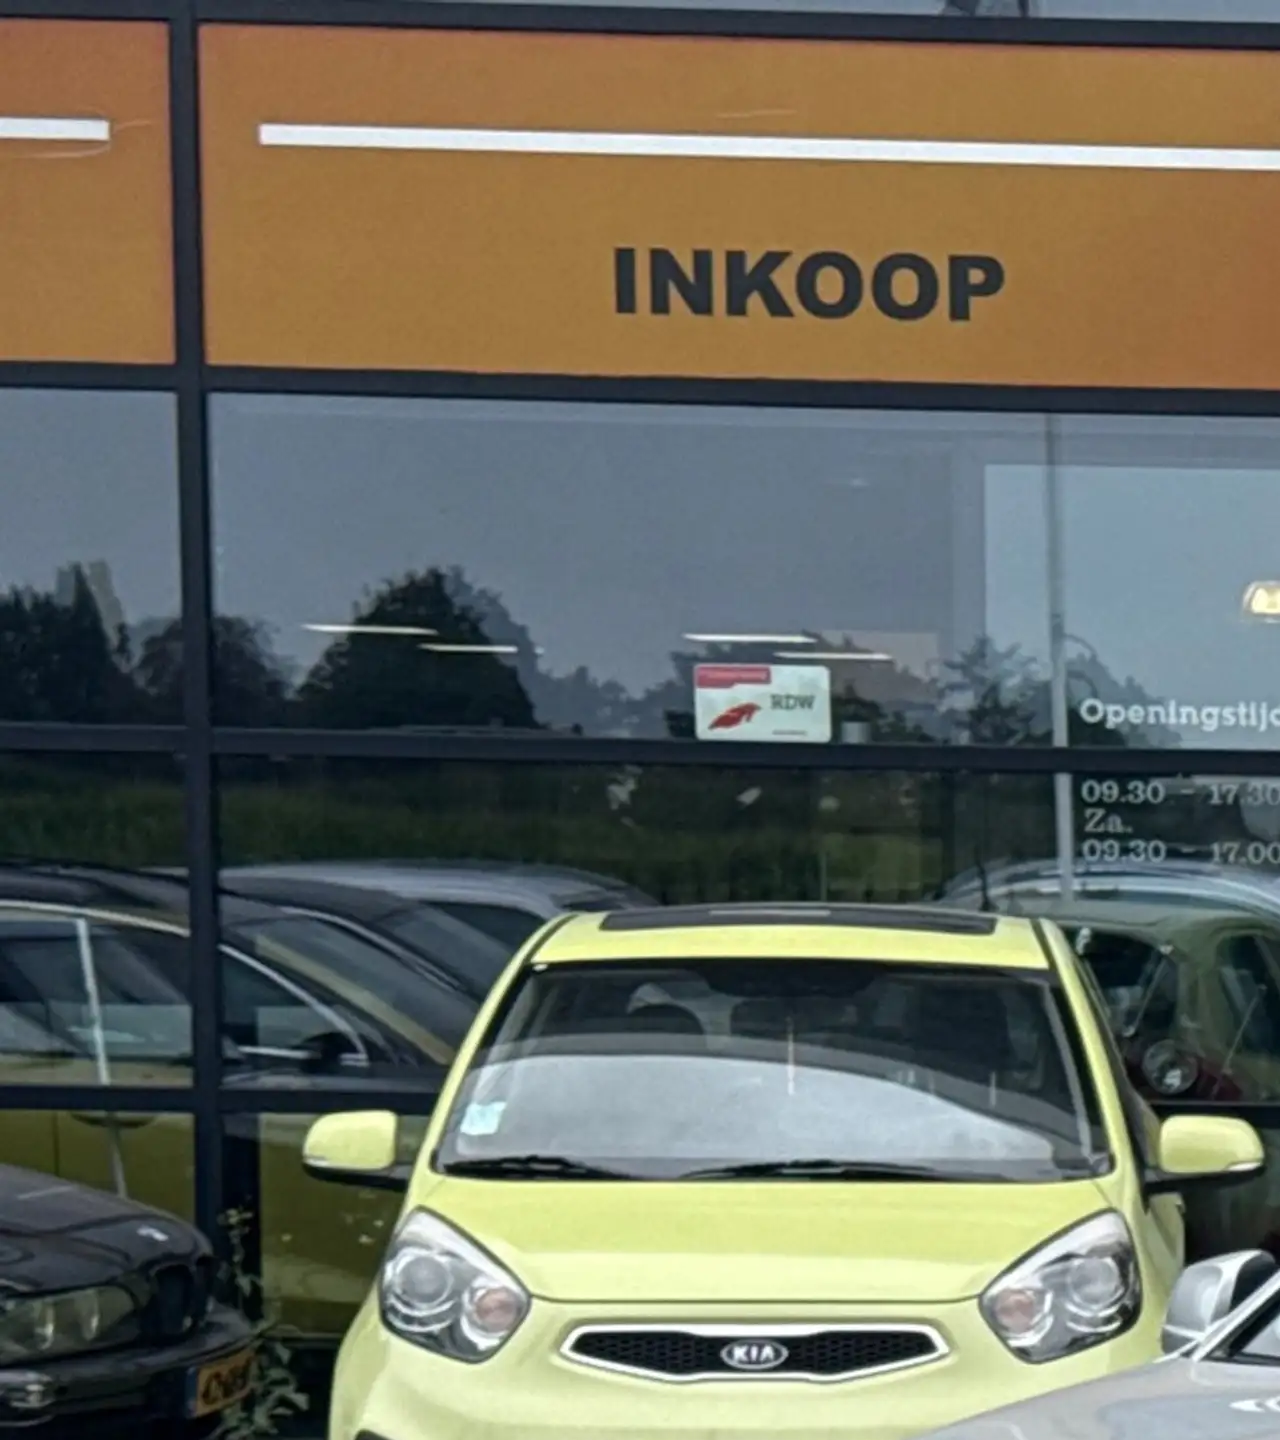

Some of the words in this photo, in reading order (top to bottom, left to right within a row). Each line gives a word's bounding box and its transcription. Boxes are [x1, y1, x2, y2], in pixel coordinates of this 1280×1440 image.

[614, 246, 1005, 322] INKOOP
[1081, 780, 1166, 805] 09.30
[1084, 808, 1133, 833] Za.
[1082, 839, 1167, 864] 09.30
[733, 1344, 775, 1362] KIA
